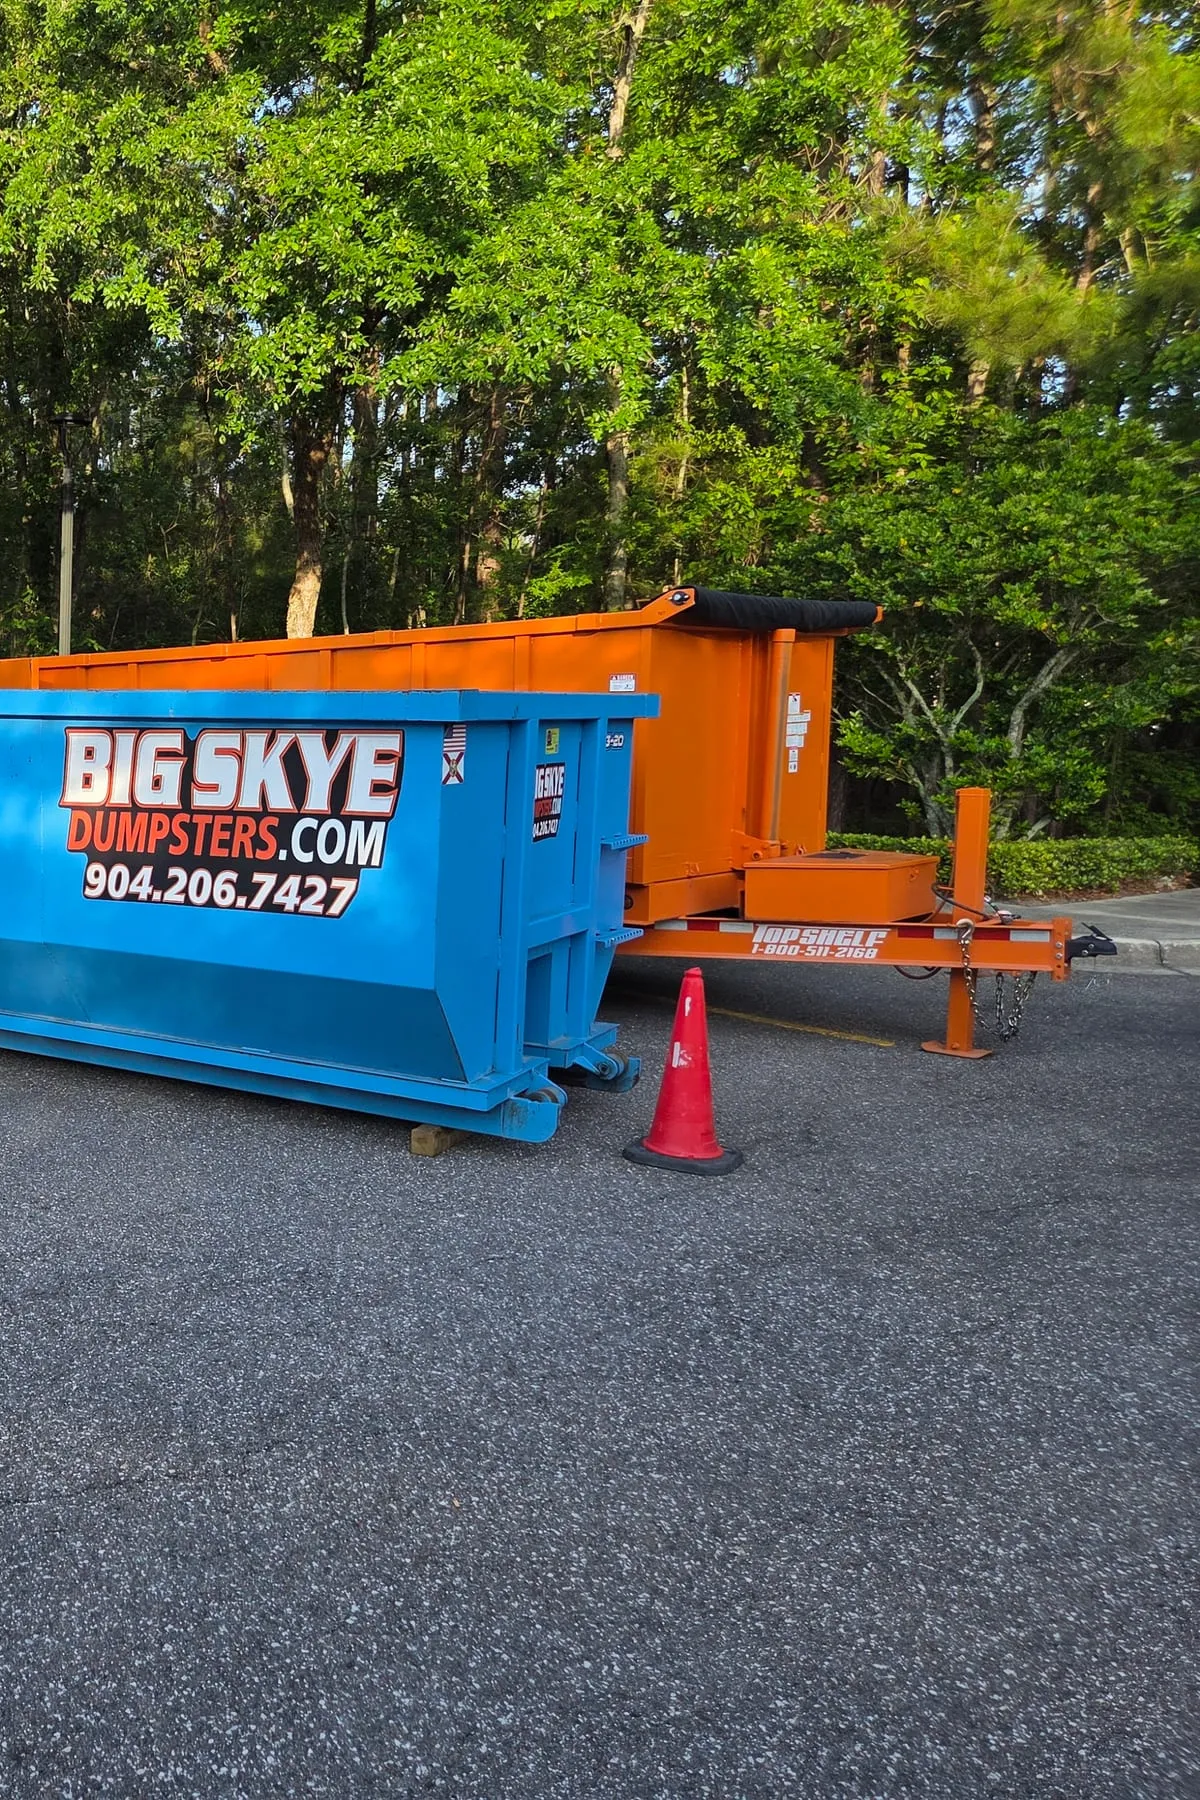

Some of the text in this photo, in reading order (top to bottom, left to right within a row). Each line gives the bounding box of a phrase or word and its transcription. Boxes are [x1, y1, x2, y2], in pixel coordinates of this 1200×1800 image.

[59, 728, 404, 817] BIG SKYE
[67, 810, 386, 866] DUMPSTERS.COM
[84, 862, 358, 916] 904.206.7427
[752, 943, 878, 959] 1-800-511-2168
